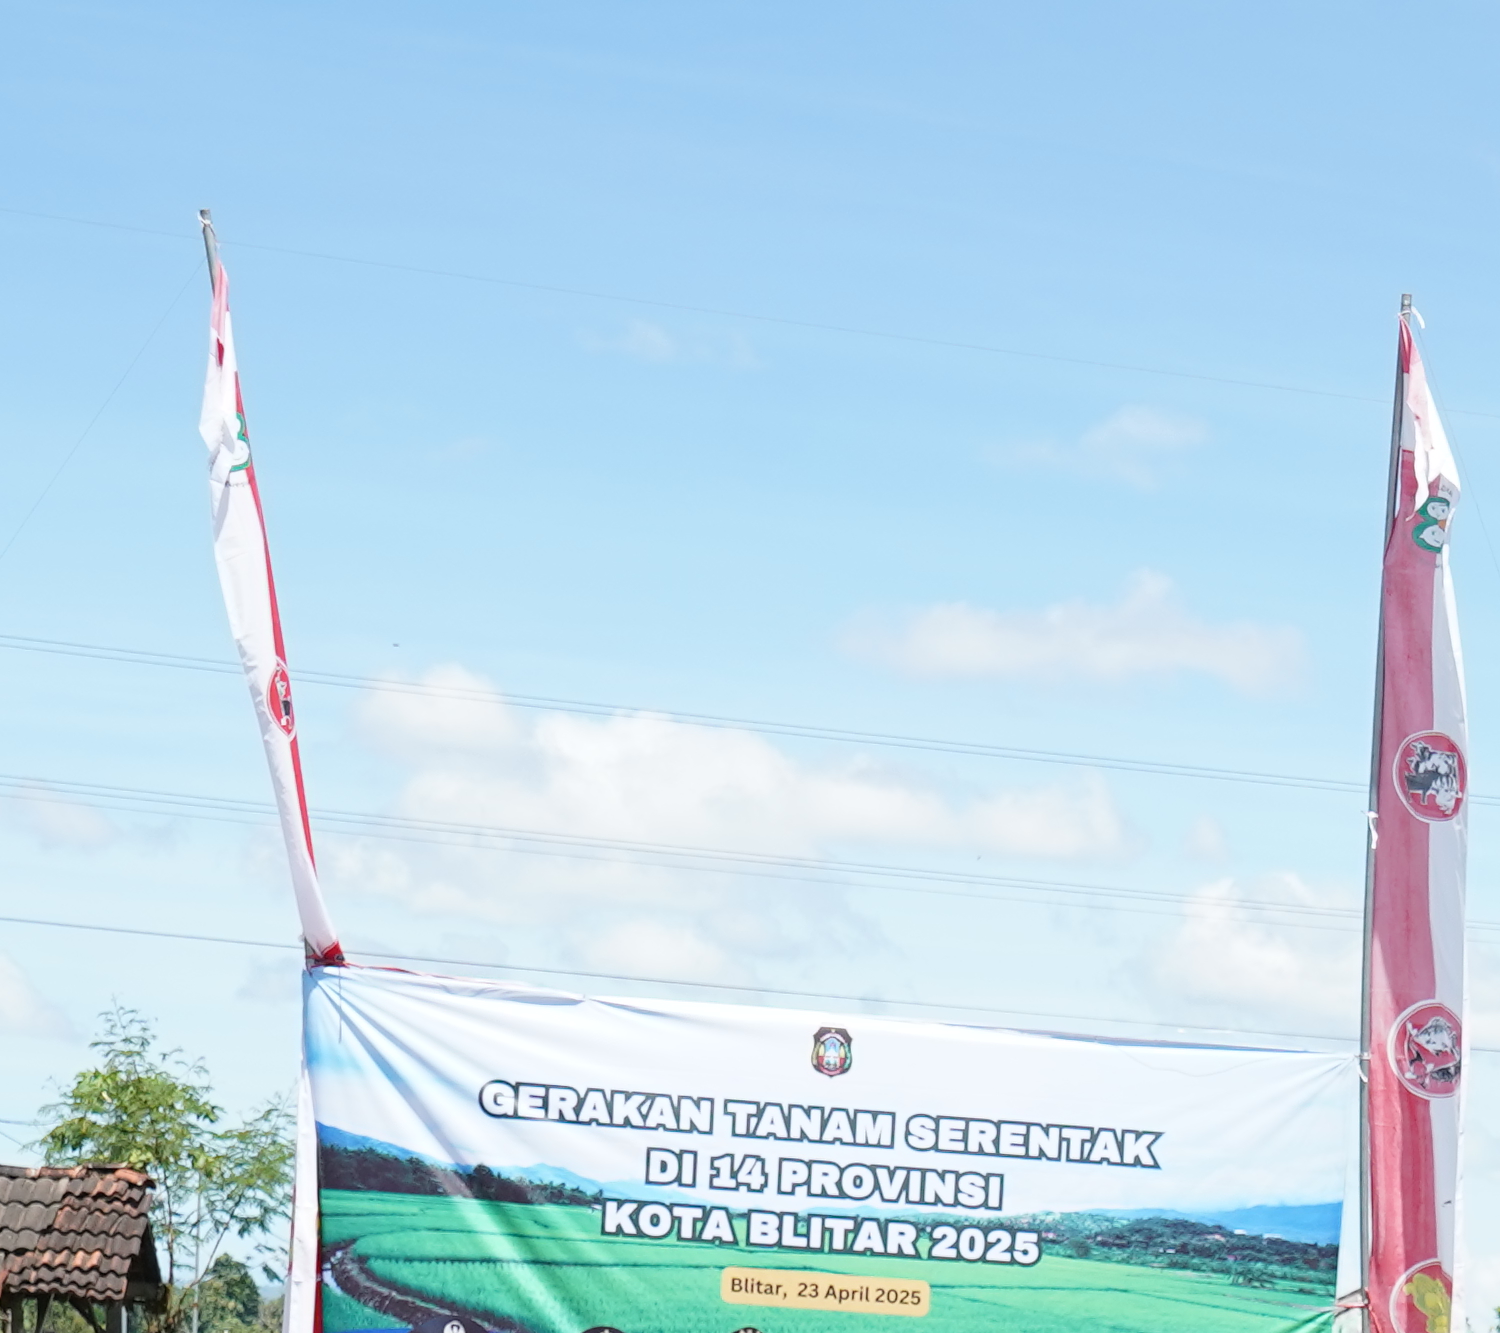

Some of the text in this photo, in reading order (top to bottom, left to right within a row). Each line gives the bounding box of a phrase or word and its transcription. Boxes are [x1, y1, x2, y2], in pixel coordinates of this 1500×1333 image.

[479, 1079, 1166, 1169] GERAKAN TANAM SERENTAK
[646, 1147, 1004, 1211] DI 14 PROVINSI
[601, 1199, 1043, 1267] KOTA BLITAR 2025
[730, 1277, 922, 1306] Blitar, 23 April 2025
